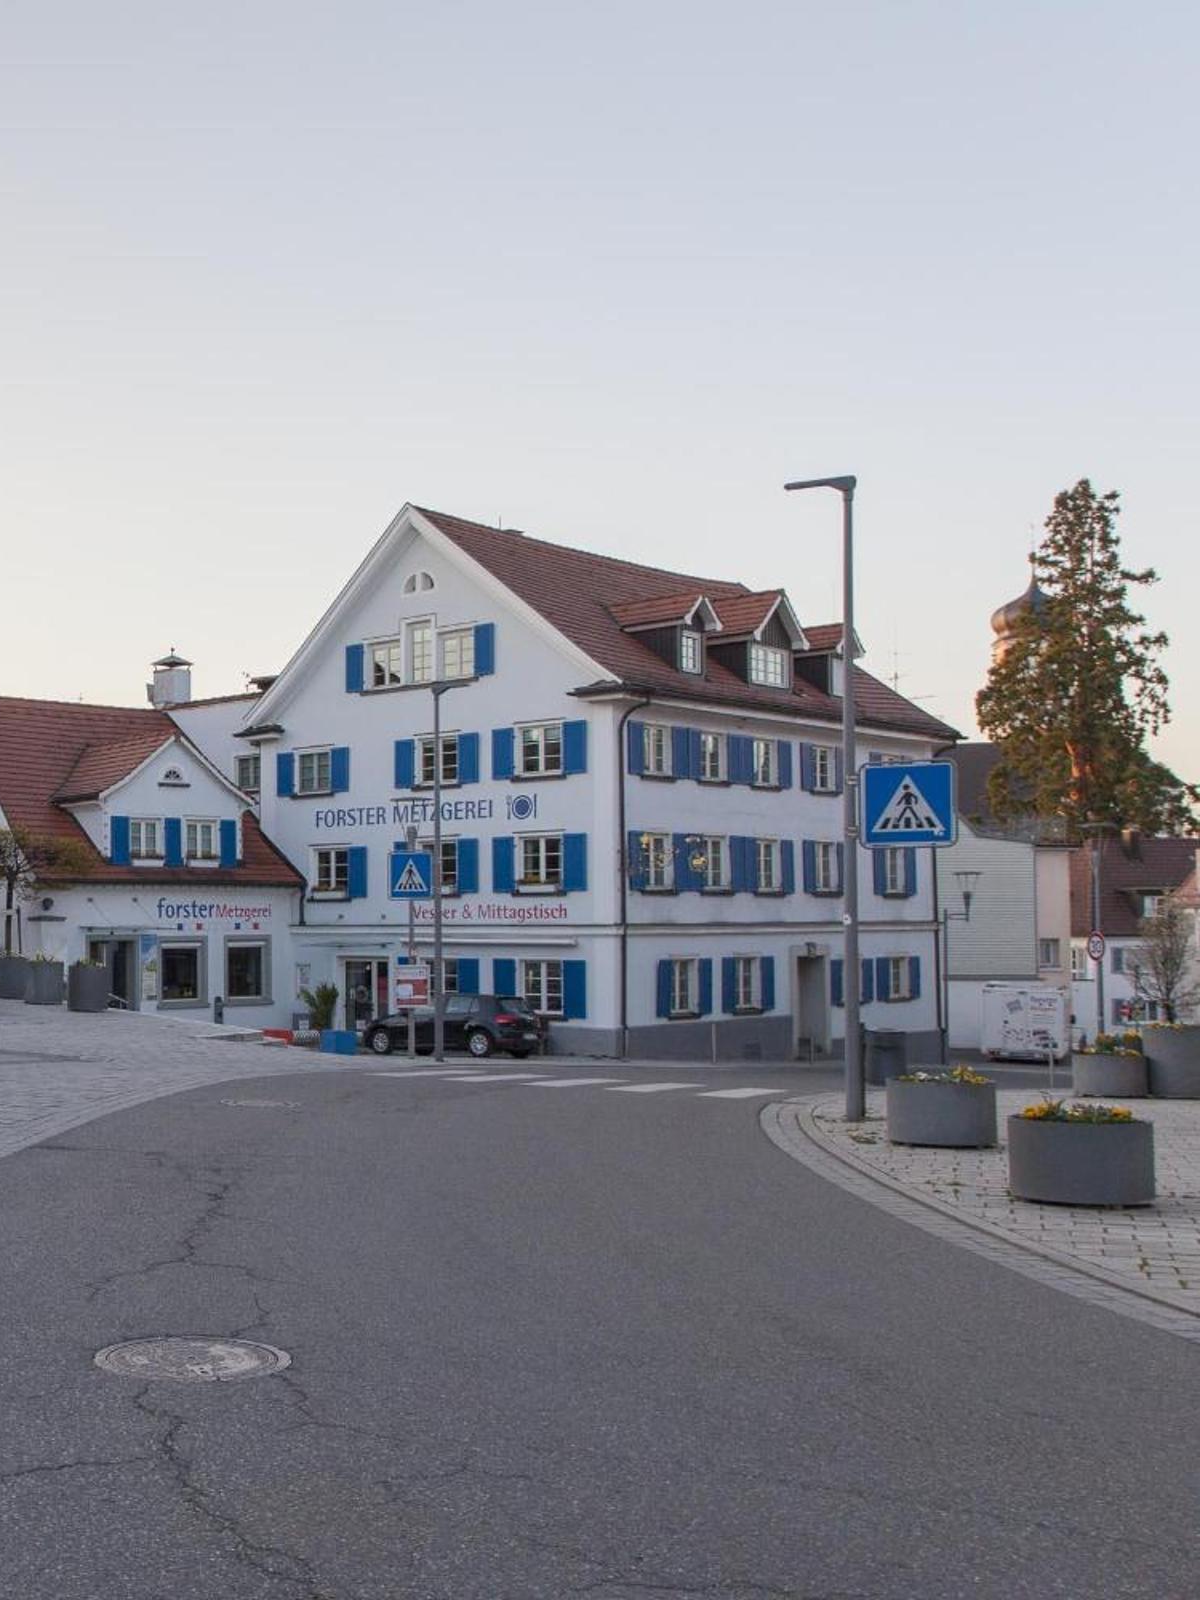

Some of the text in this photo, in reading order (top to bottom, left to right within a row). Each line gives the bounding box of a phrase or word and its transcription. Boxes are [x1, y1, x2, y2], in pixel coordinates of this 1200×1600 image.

[315, 806, 386, 828] FORSTER
[412, 903, 568, 923] Veser & Mittagstisch
